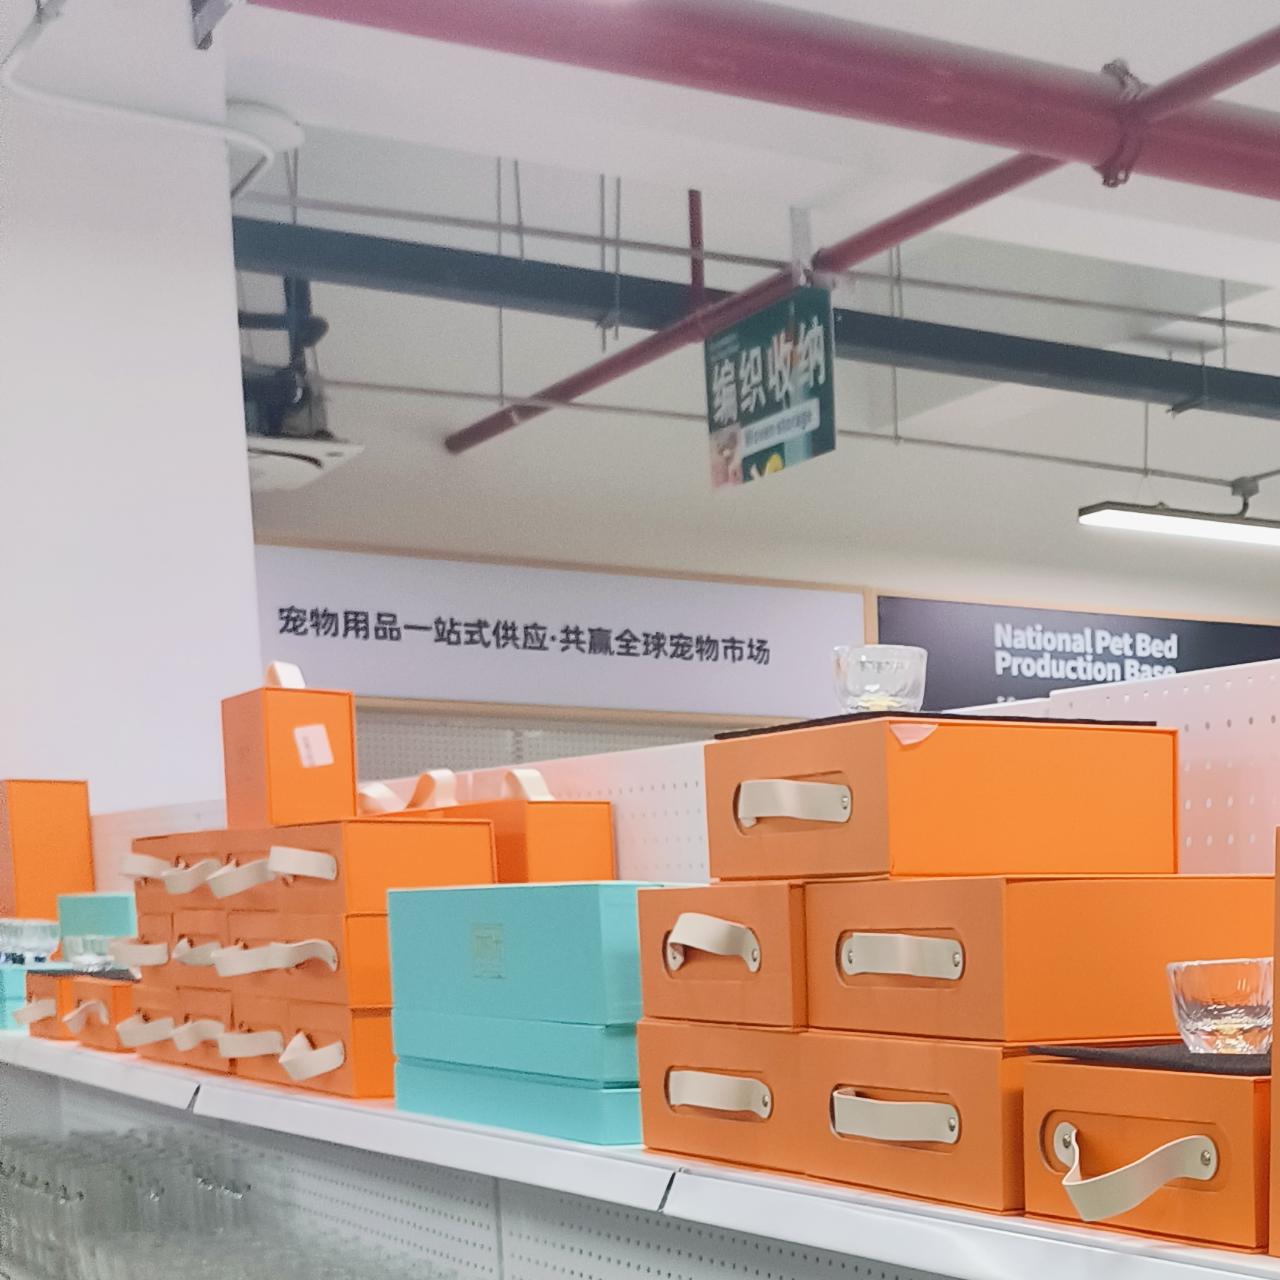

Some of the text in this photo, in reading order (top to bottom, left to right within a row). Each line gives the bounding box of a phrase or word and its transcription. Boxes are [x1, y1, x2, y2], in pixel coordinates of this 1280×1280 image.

[711, 316, 826, 425] 编织收纳
[278, 605, 770, 666] 宠物用品一站式供应·共赢全球宠物市场
[994, 623, 1178, 659] National Pet Bed
[995, 651, 1121, 682] Production
